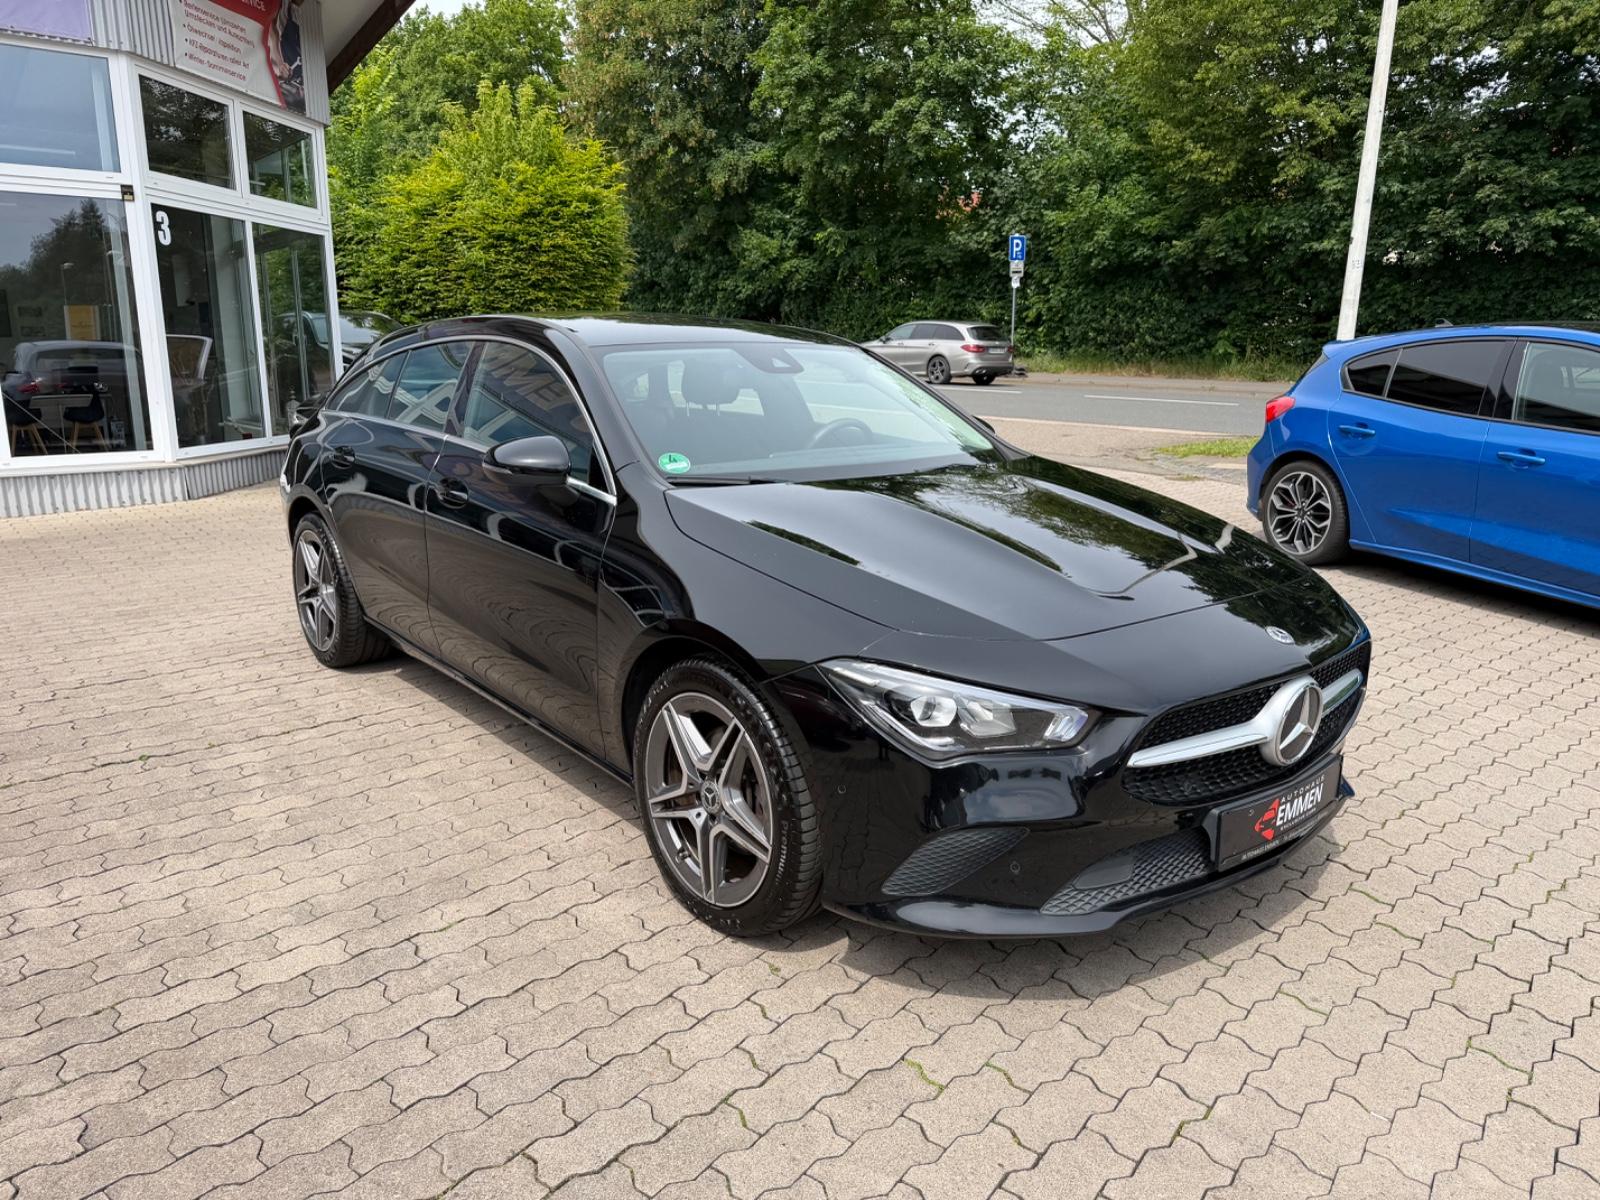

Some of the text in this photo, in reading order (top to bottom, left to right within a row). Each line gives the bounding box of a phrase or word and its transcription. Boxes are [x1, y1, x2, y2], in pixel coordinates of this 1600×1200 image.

[156, 210, 171, 246] 3
[1013, 239, 1022, 259] P
[1276, 782, 1325, 827] EMMEN
[1281, 774, 1326, 803] AUTOHAUS
